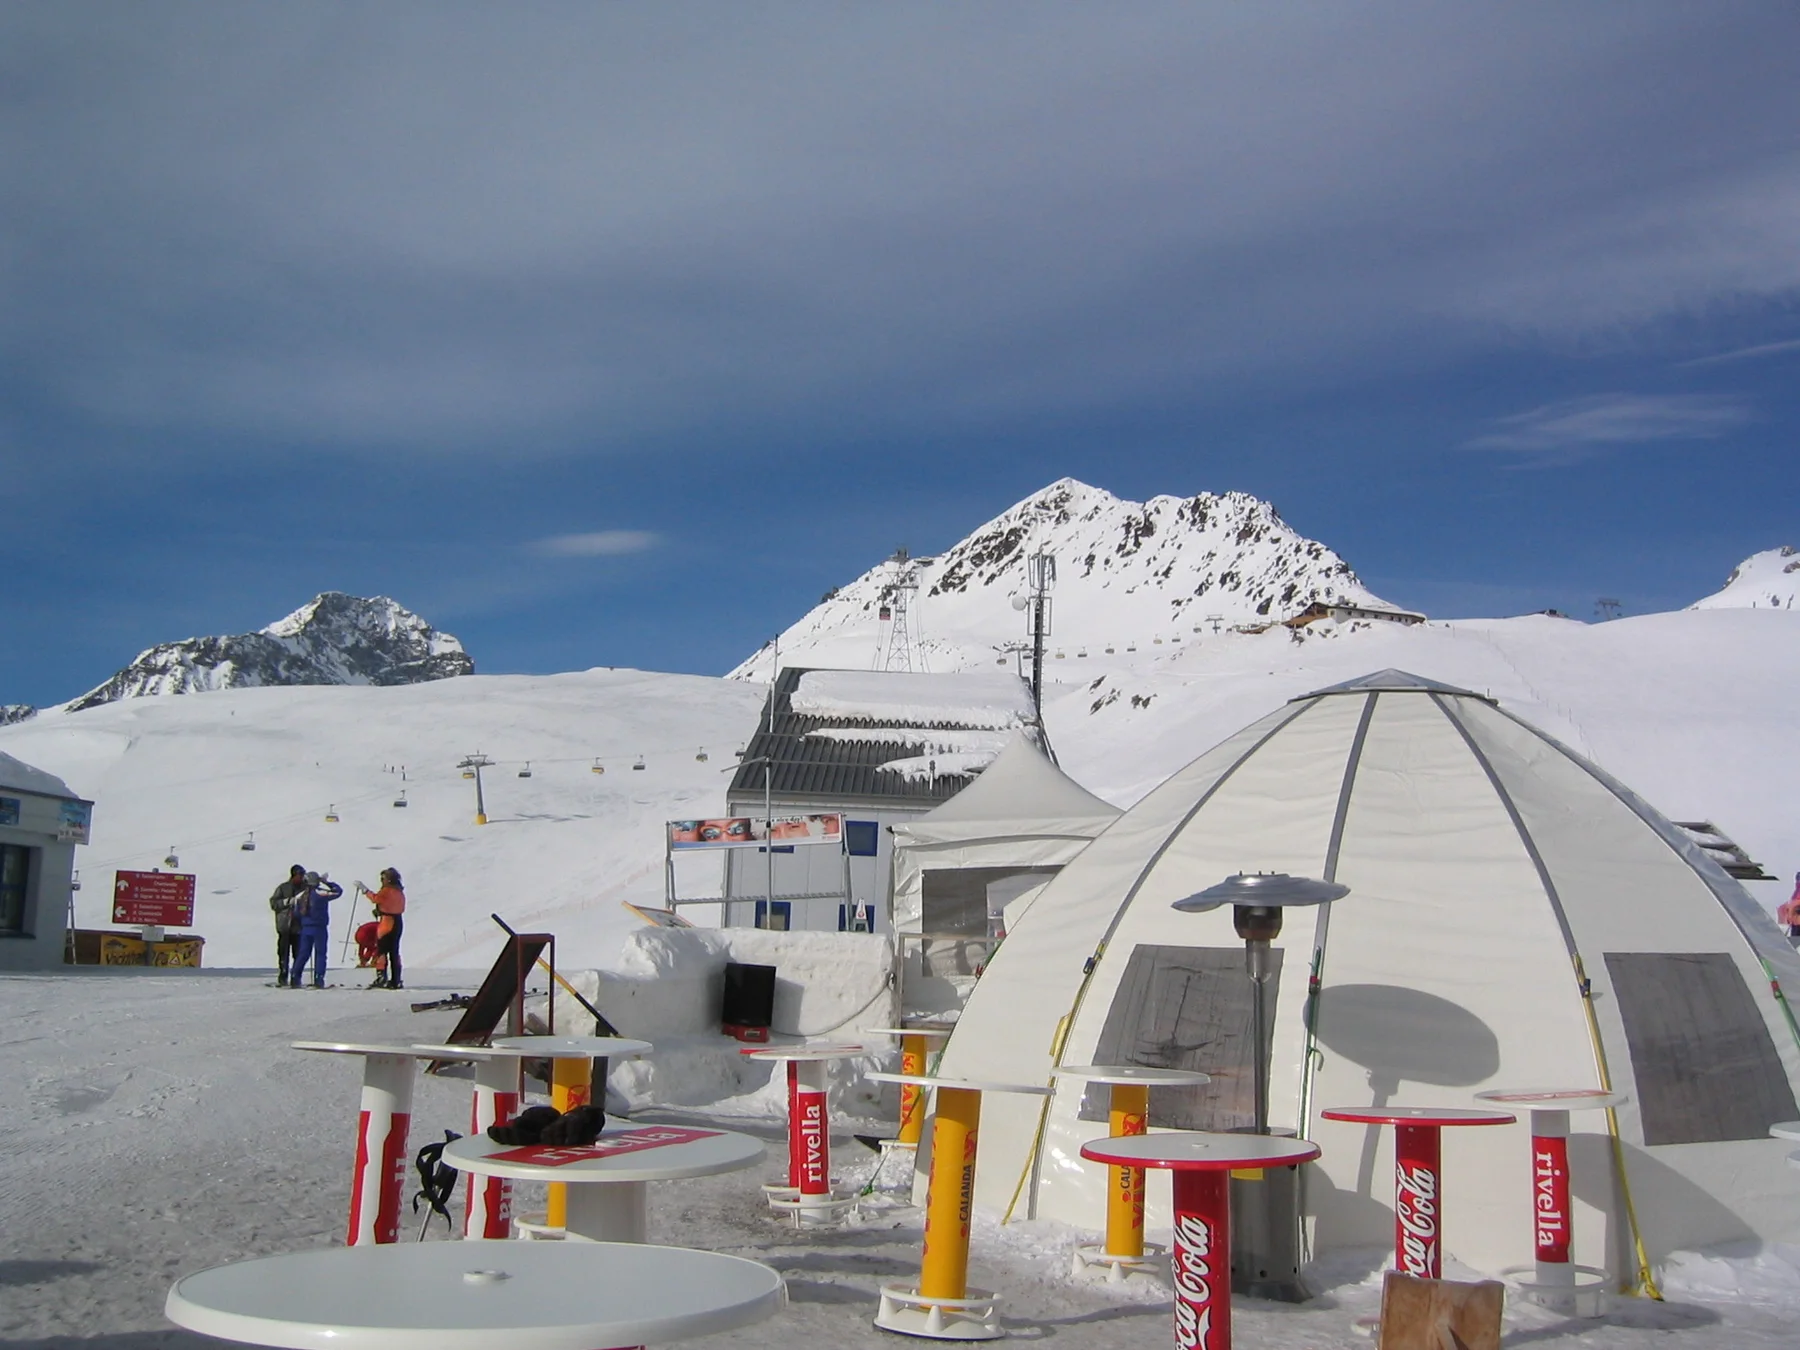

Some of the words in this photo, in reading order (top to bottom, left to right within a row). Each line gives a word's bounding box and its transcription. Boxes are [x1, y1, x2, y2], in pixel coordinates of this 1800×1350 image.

[802, 1105, 822, 1183] rivella
[959, 1164, 973, 1222] CALANDA
[1397, 1162, 1435, 1278] ca-Cola
[1537, 1152, 1562, 1247] rivella
